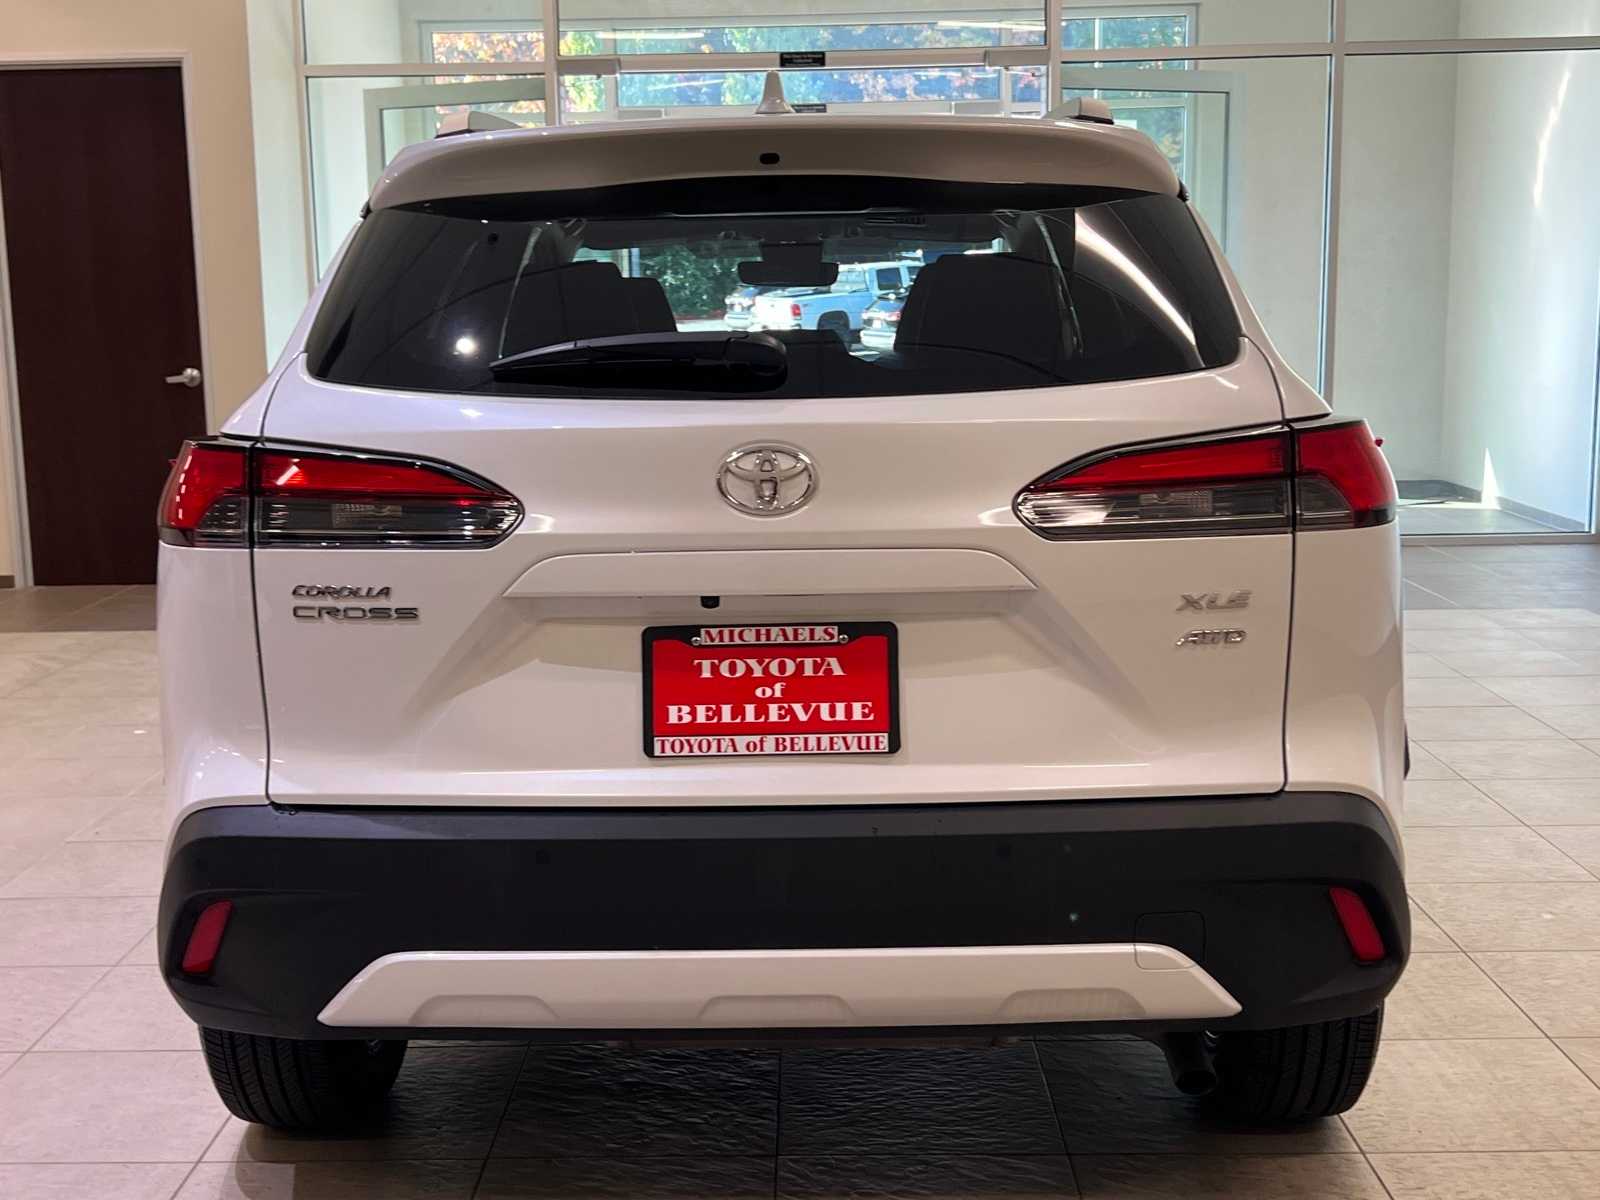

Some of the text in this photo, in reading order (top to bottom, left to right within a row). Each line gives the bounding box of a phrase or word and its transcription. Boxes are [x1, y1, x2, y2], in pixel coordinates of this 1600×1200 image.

[292, 584, 392, 599] COROLLA
[1176, 590, 1251, 610] XLE
[293, 606, 419, 619] CROSS
[704, 627, 836, 643] MICHAELS
[694, 658, 846, 678] TOYOTA
[755, 682, 786, 698] of
[666, 702, 874, 724] BELLEVUE
[656, 734, 886, 754] TOYOTA of BELLEVUE
